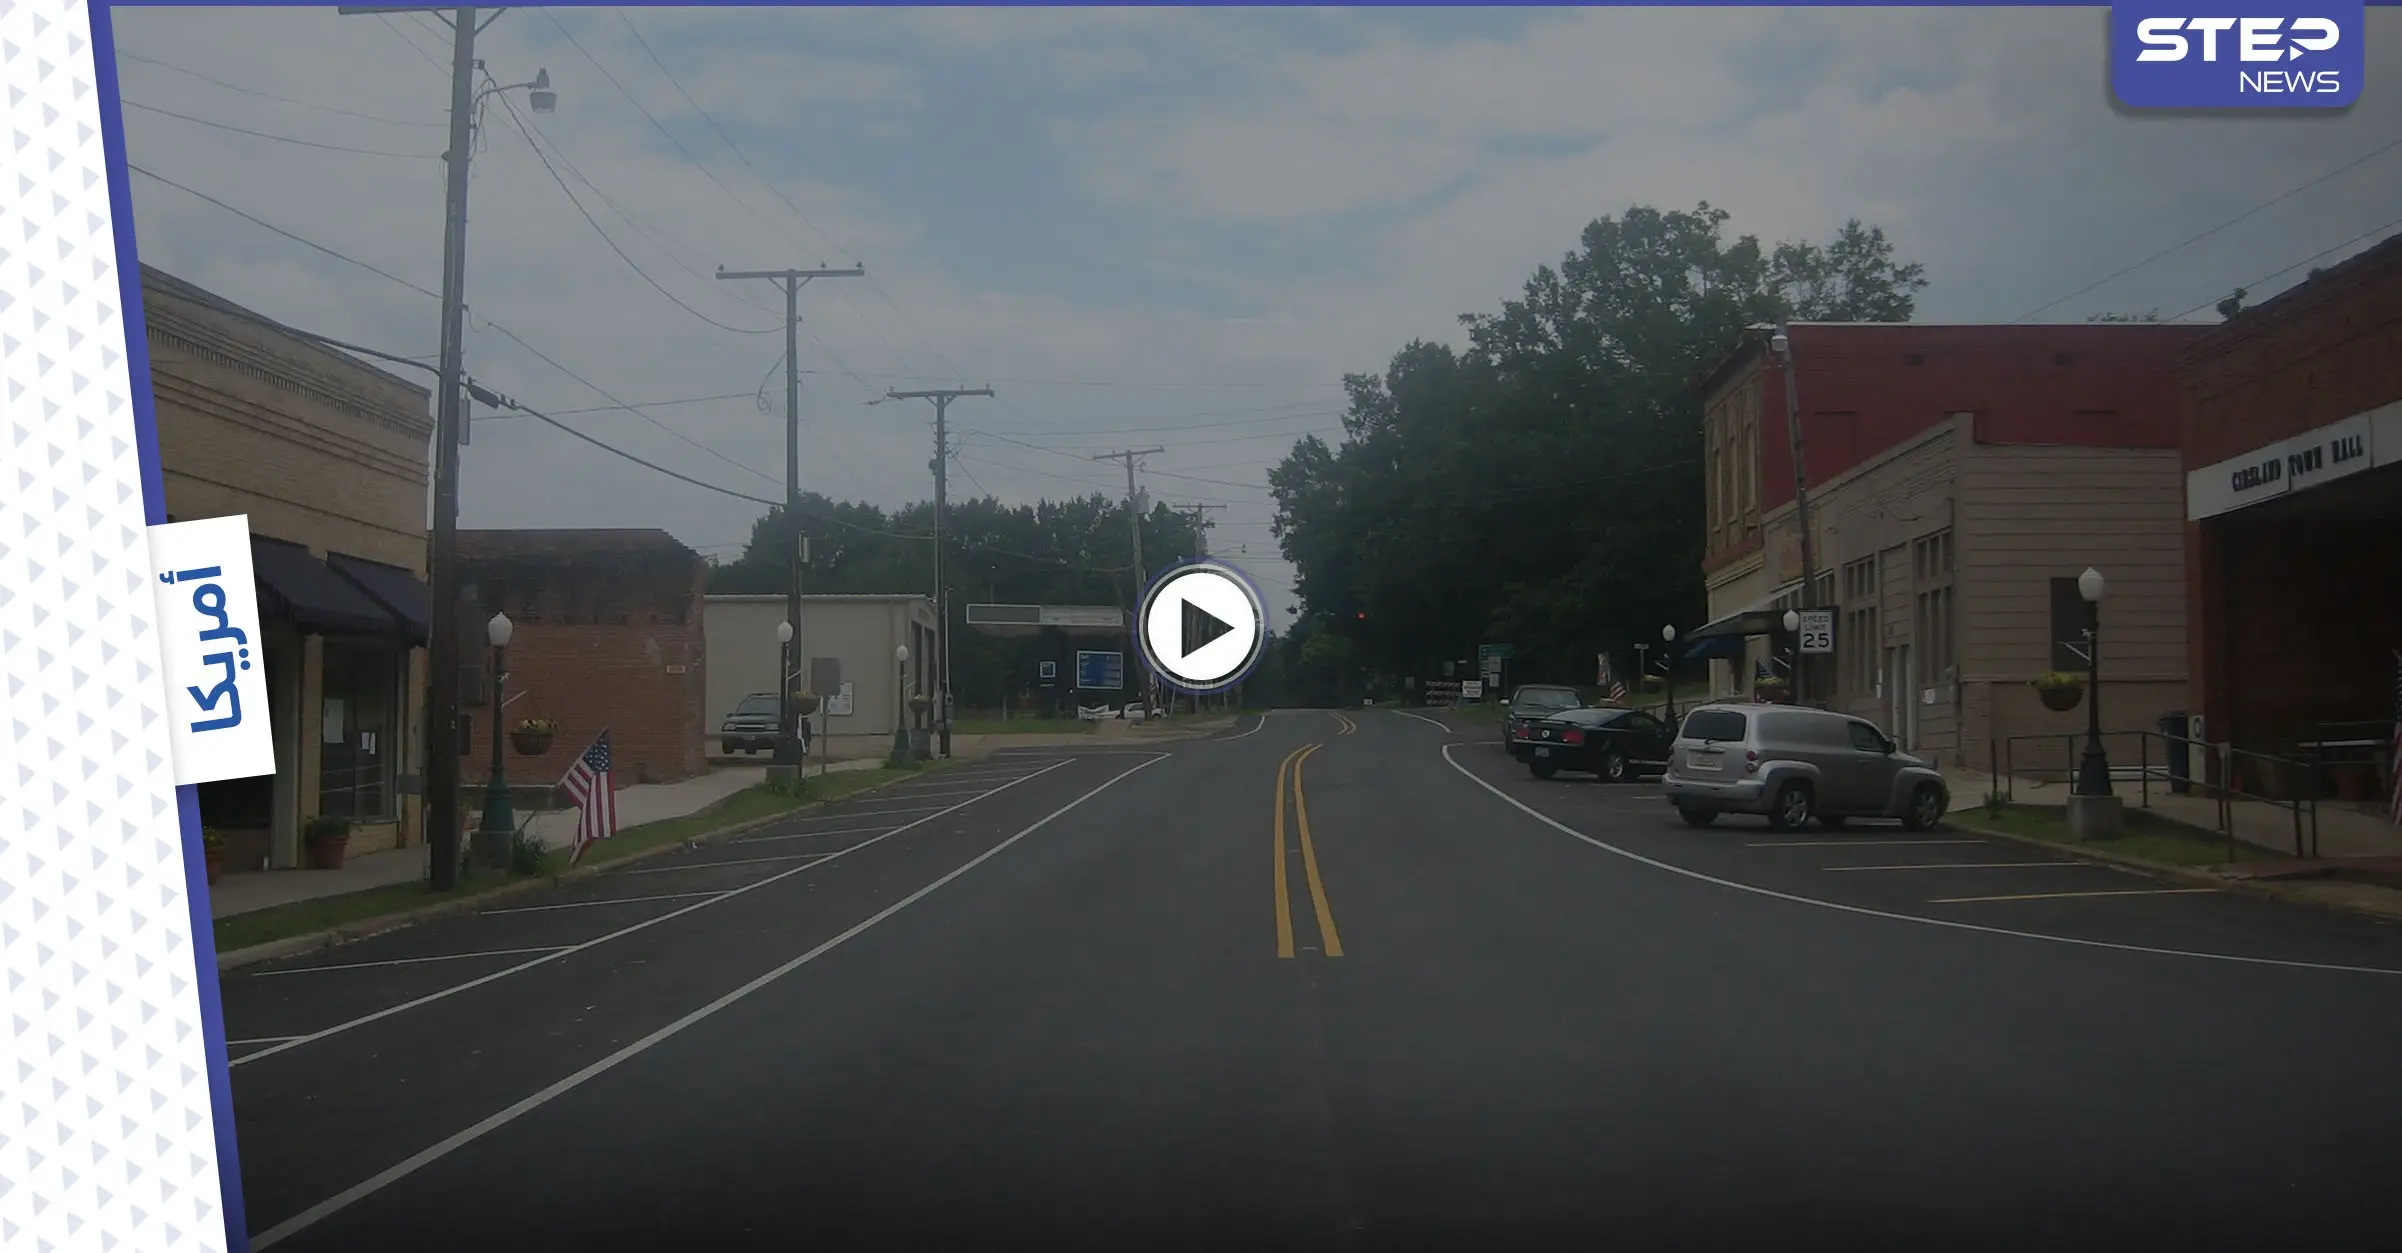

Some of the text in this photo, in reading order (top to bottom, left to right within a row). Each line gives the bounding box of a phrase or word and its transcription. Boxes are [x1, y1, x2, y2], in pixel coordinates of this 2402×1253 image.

[2288, 446, 2322, 476] TOWN
[2331, 434, 2363, 463] HALL
[1803, 633, 1829, 648] 25
